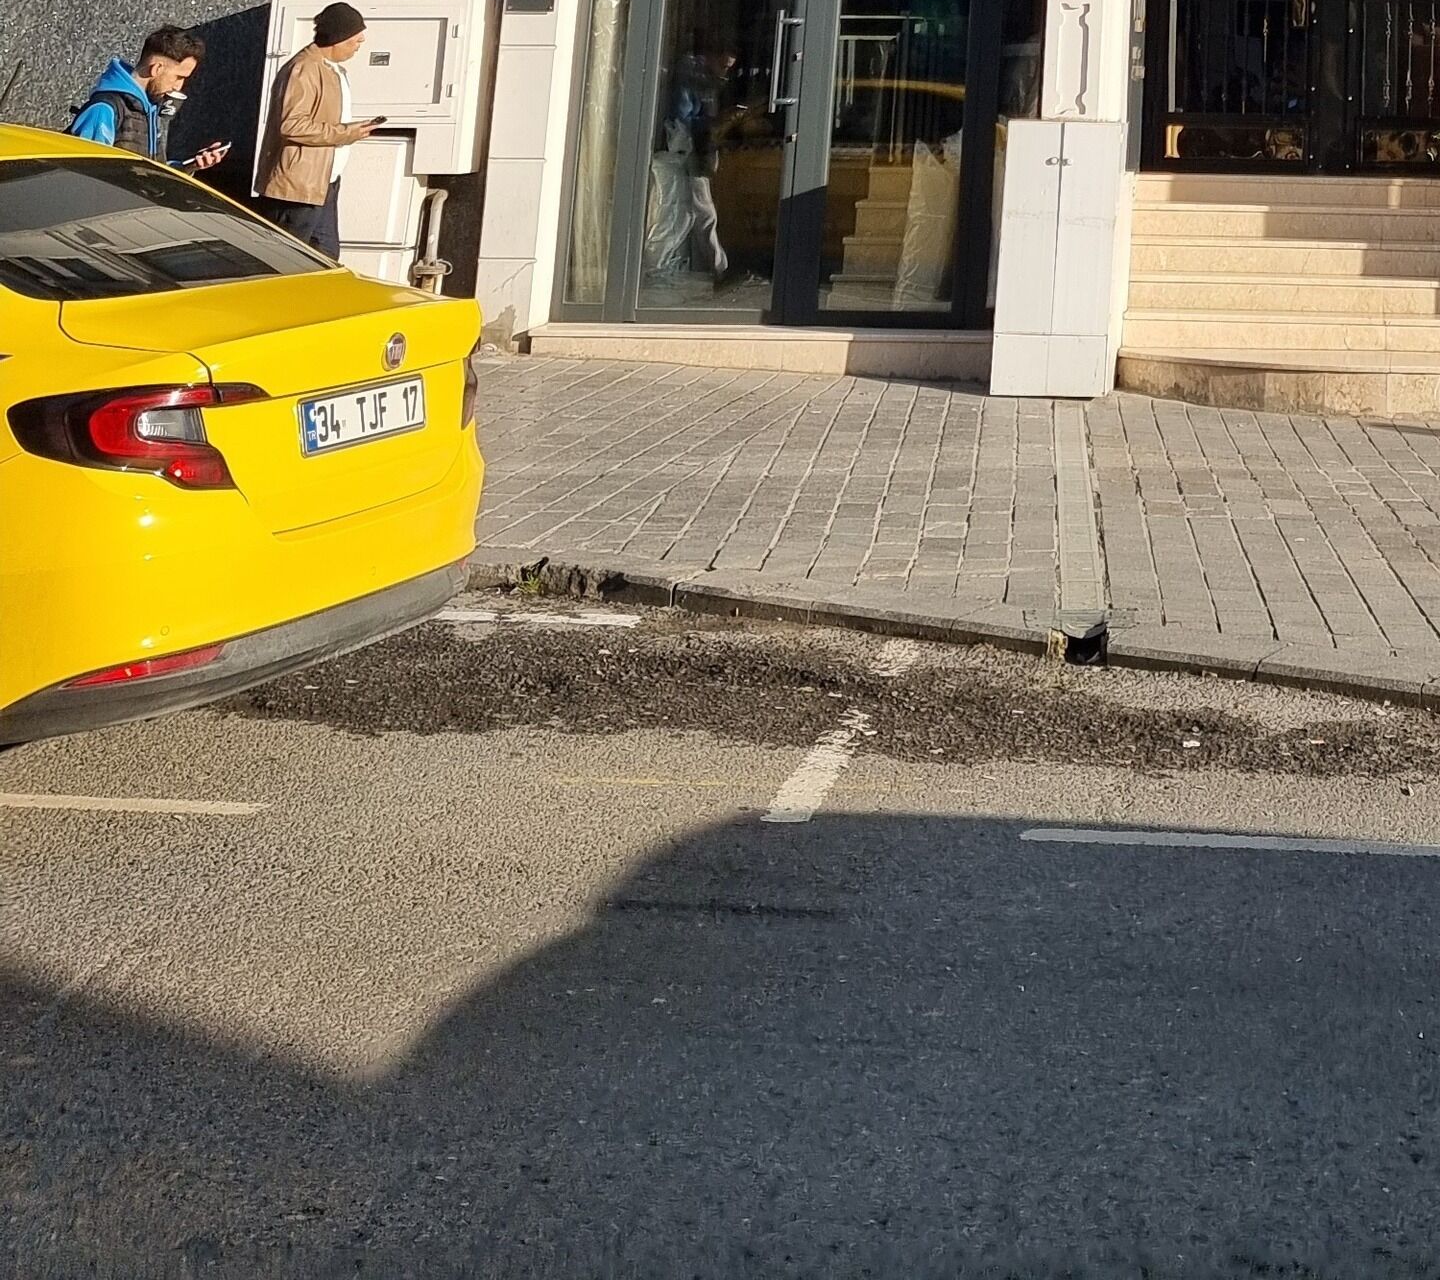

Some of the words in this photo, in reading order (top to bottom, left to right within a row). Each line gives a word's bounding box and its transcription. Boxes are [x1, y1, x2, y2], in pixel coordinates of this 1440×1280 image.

[316, 403, 341, 443] 34
[356, 391, 388, 434] TJF
[402, 384, 418, 423] 17
